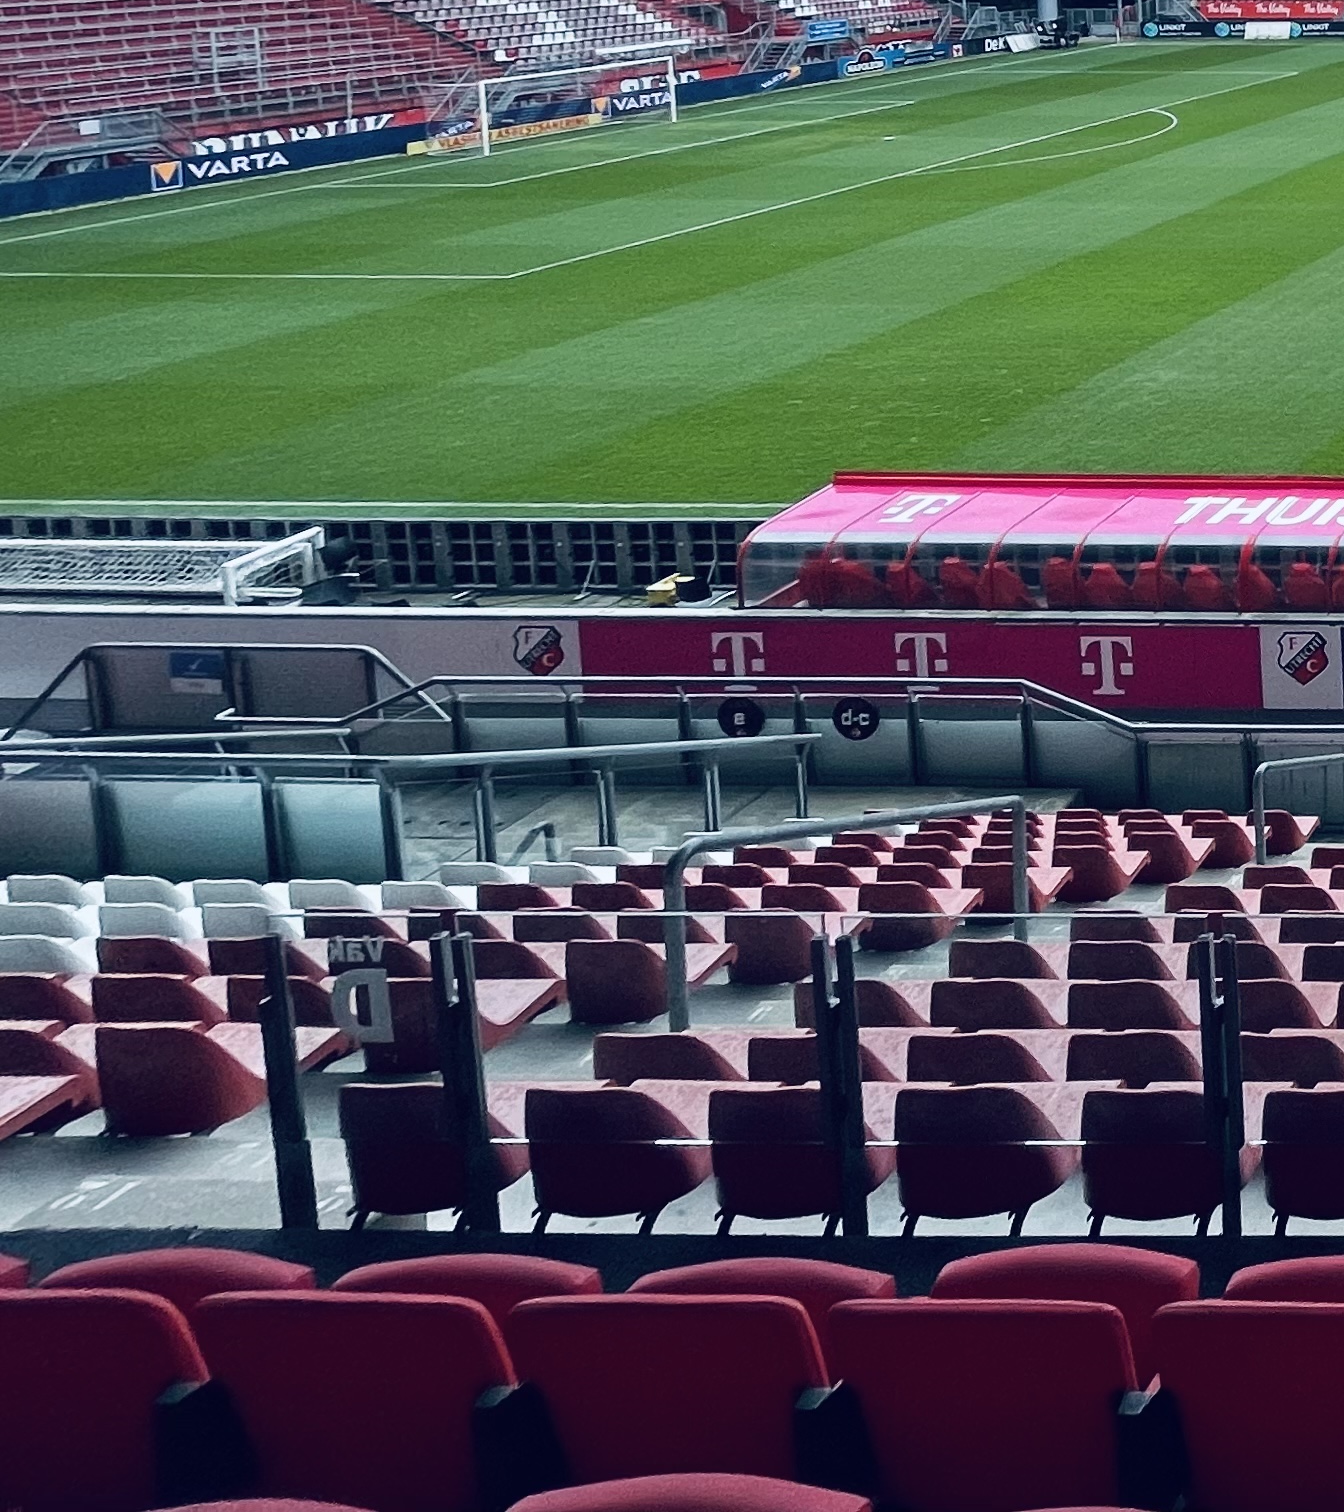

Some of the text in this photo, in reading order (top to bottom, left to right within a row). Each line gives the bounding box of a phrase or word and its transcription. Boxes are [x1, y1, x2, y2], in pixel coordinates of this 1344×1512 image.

[613, 91, 673, 112] VARTA
[187, 151, 289, 179] VARTA
[1289, 637, 1298, 650] F
[711, 632, 765, 691] T
[894, 632, 948, 692] T
[1080, 636, 1133, 695] T
[1307, 659, 1318, 673] C
[841, 710, 870, 727] d-c
